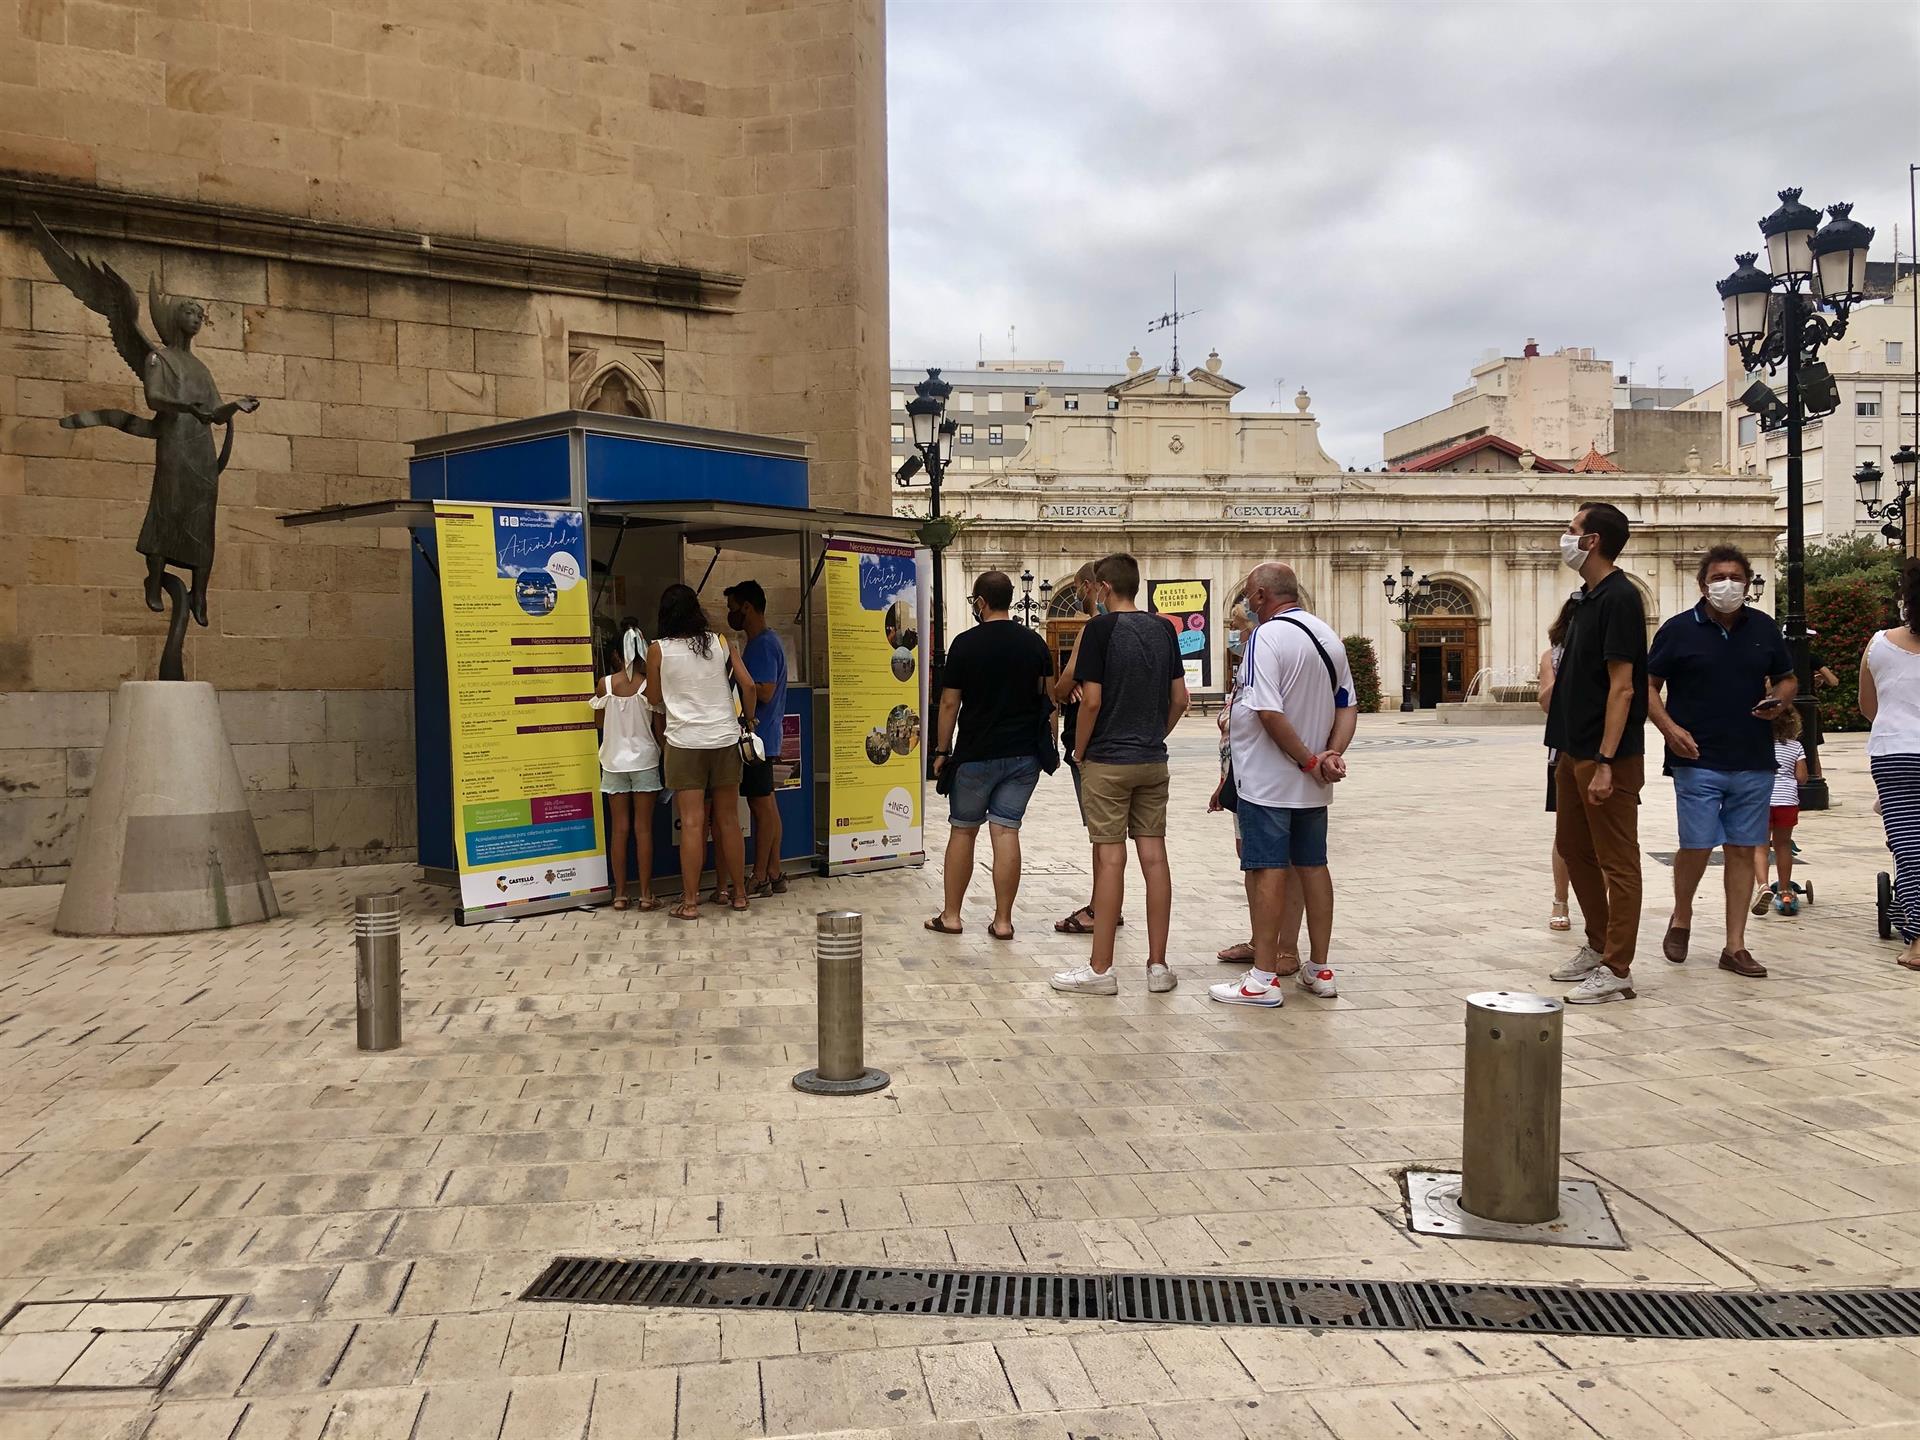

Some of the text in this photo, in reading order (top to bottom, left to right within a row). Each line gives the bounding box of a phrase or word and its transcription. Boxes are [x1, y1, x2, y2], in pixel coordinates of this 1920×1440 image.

[1234, 506, 1301, 516] CENTRAL
[499, 529, 578, 566] Actividades
[849, 542, 876, 553] Necesario
[876, 546, 897, 554] reservar
[551, 563, 575, 576] +INFO
[862, 566, 896, 589] Visitas
[878, 572, 914, 598] guiadas
[888, 801, 909, 814] +INFO
[509, 875, 535, 884] CASTELLÓ
